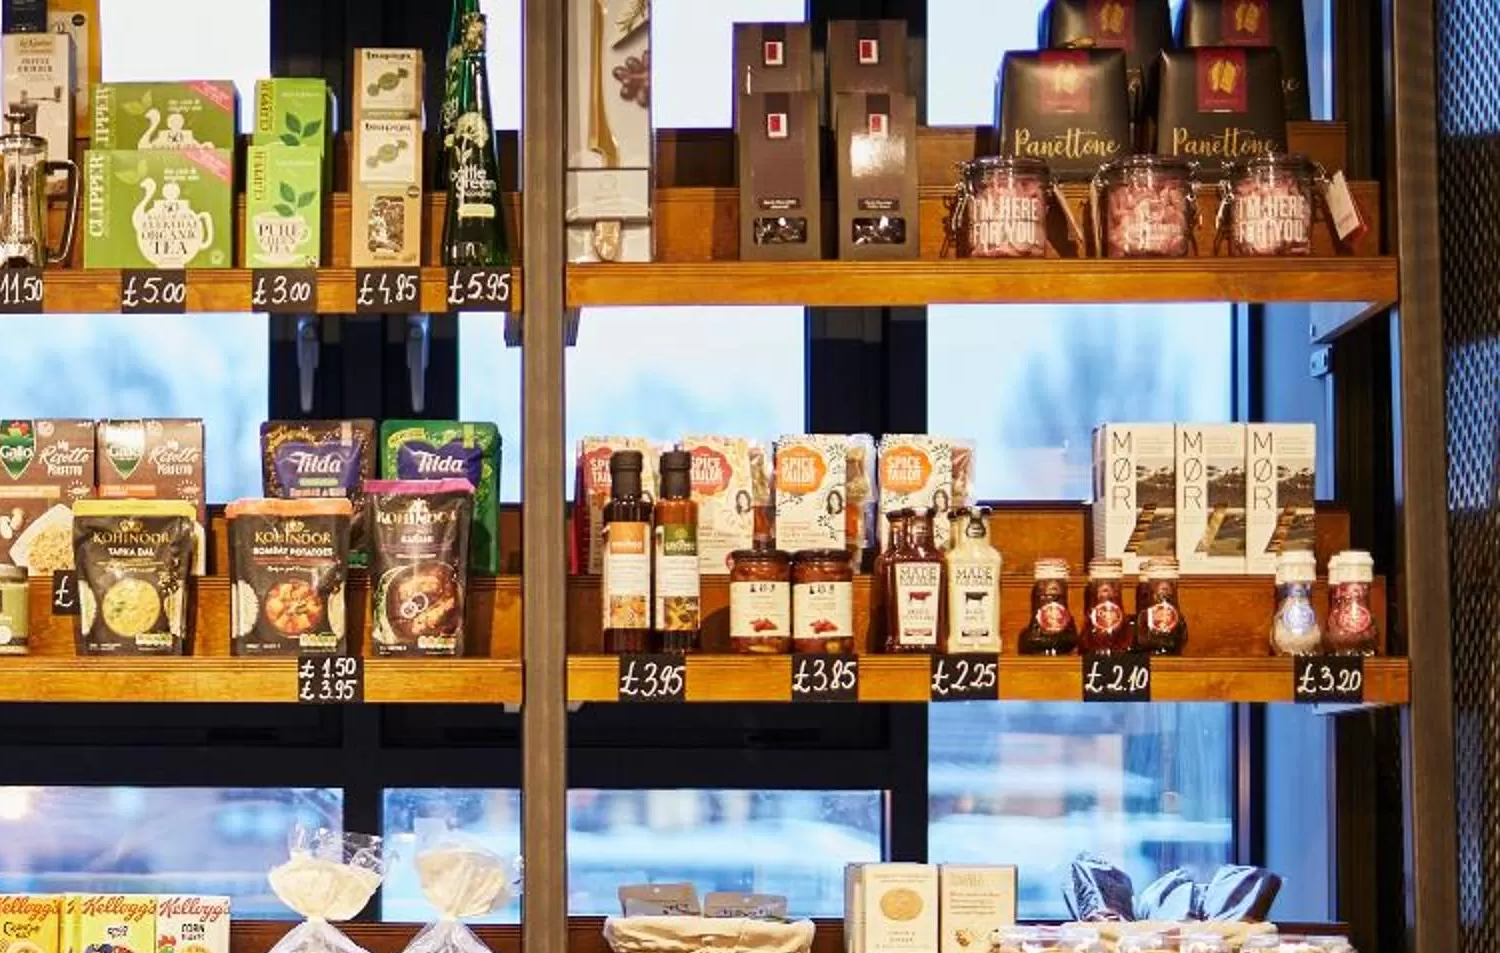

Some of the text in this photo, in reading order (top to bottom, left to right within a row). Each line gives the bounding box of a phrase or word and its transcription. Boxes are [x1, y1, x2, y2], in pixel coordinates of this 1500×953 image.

[1015, 127, 1122, 158] Panettone
[1172, 127, 1279, 157] Panettone
[456, 177, 496, 191] green
[89, 155, 105, 237] CLIPPER
[1262, 196, 1306, 219] HERE
[999, 198, 1038, 220] HERE
[141, 230, 197, 241] ORGANIC
[258, 223, 297, 237] PURE
[973, 222, 998, 245] FOR
[150, 241, 188, 255] TEA
[122, 274, 187, 307] £5.00
[252, 274, 312, 306] £3.00
[357, 272, 418, 306] £4.85
[447, 271, 511, 304] £5.95
[291, 451, 342, 473] Tilda
[411, 451, 464, 473] Tilda
[92, 531, 169, 545] KOHINOOR
[254, 530, 332, 545] KOHINOOR
[107, 547, 136, 557] TARKA
[253, 546, 288, 555] BOMBAY
[956, 568, 993, 580] MADE
[299, 657, 357, 679] £1.50
[620, 661, 685, 697] £3.95
[792, 659, 857, 694] £3.85
[931, 660, 998, 693] £2.25
[1085, 663, 1150, 693] £2.10
[1297, 664, 1362, 694] £3.20
[300, 680, 357, 700] £3.95
[83, 896, 156, 922] Kellogg's
